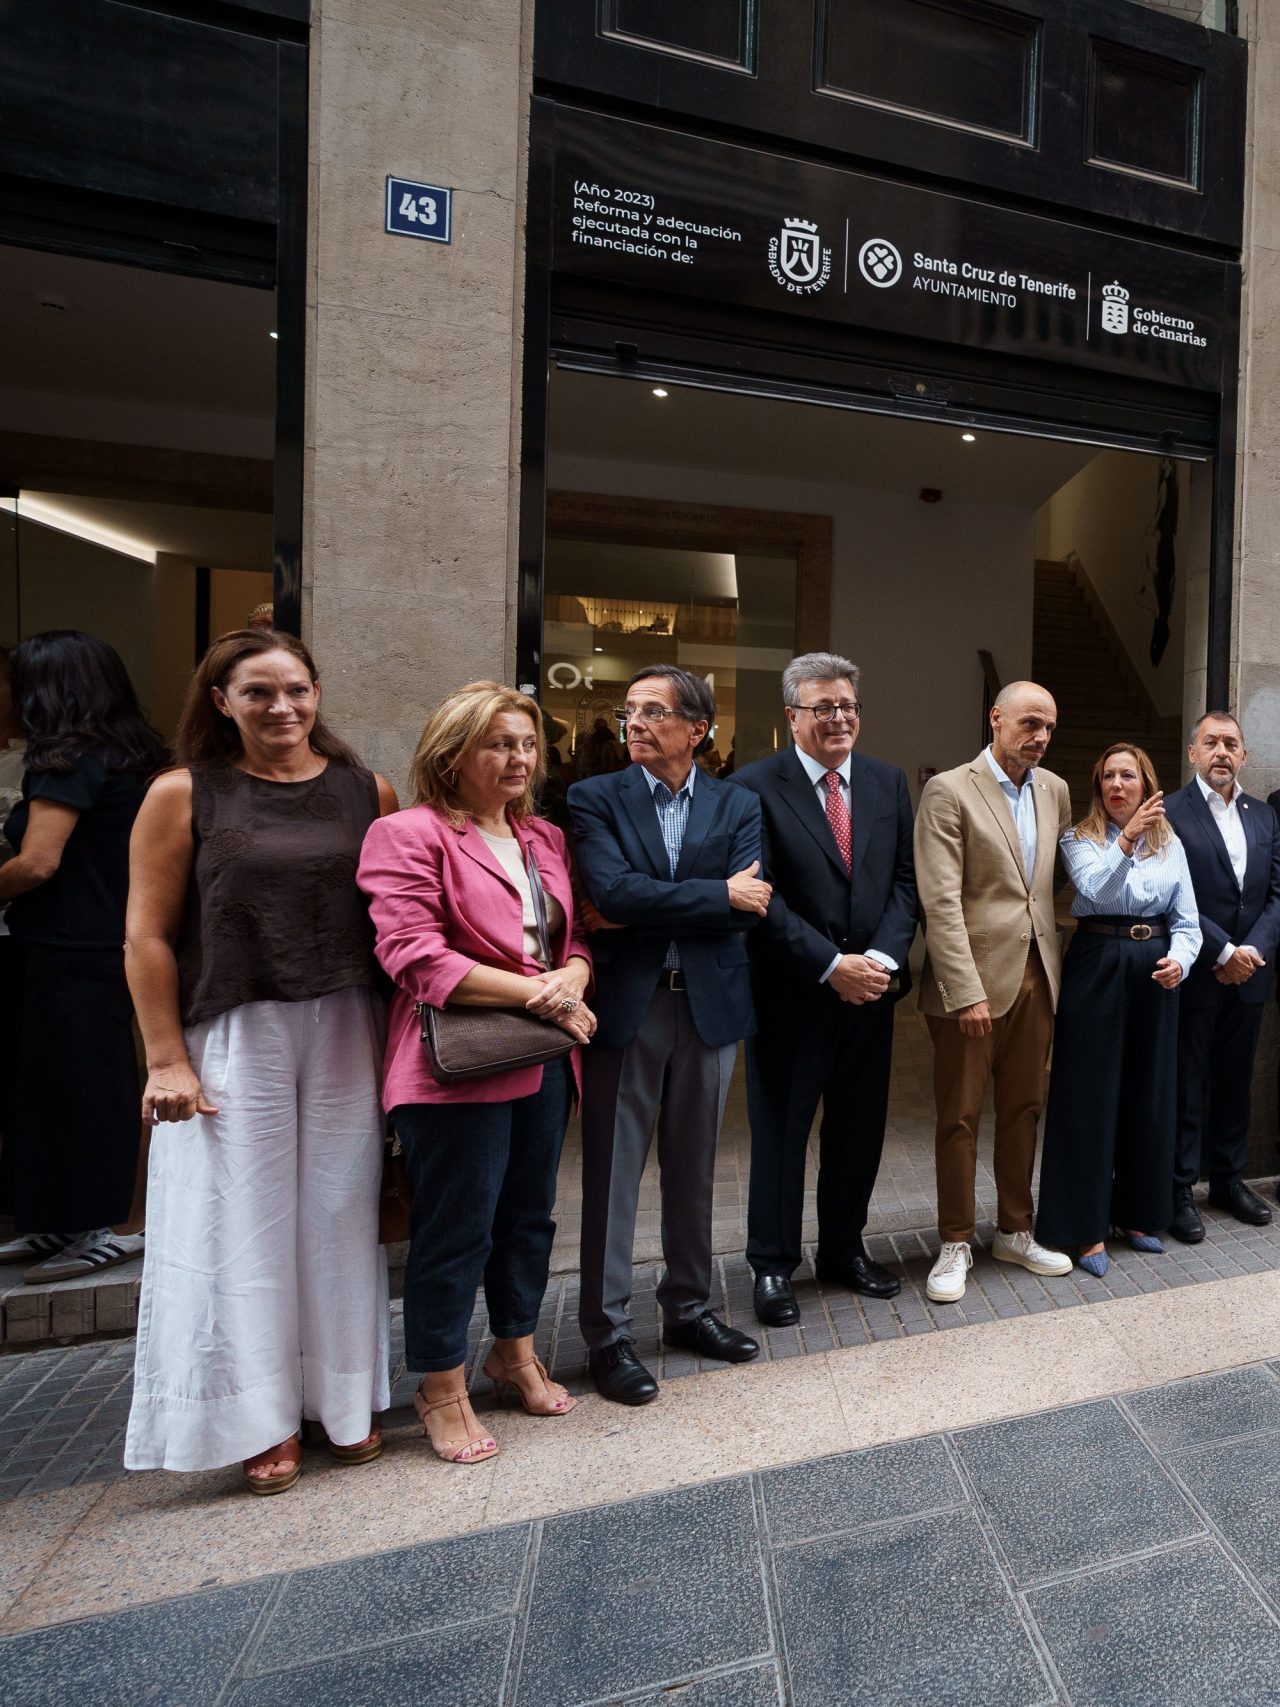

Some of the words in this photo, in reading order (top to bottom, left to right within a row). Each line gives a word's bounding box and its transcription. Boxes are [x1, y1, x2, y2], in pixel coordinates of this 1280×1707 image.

[399, 193, 437, 225] 43
[573, 180, 610, 199] (Año
[614, 189, 656, 210] 2023)
[572, 216, 649, 239] ejecutada
[653, 232, 681, 247] con
[685, 235, 698, 249] la
[573, 198, 640, 221] Reforma
[643, 213, 653, 225] y
[656, 215, 742, 242] adecuación
[571, 230, 667, 260] financiación
[671, 249, 694, 264] de:
[768, 237, 786, 285] CABILDO
[786, 282, 803, 295] DE
[804, 247, 832, 294] TENERIFE
[913, 252, 958, 276] Santa
[961, 262, 995, 284] Cruz
[999, 271, 1016, 287] de
[1019, 274, 1076, 300] Tenerife
[912, 276, 1017, 308] AYUNTAMIENTO
[1133, 307, 1194, 331] Gobierno
[1133, 322, 1149, 335] de
[1150, 324, 1207, 347] Canarias
